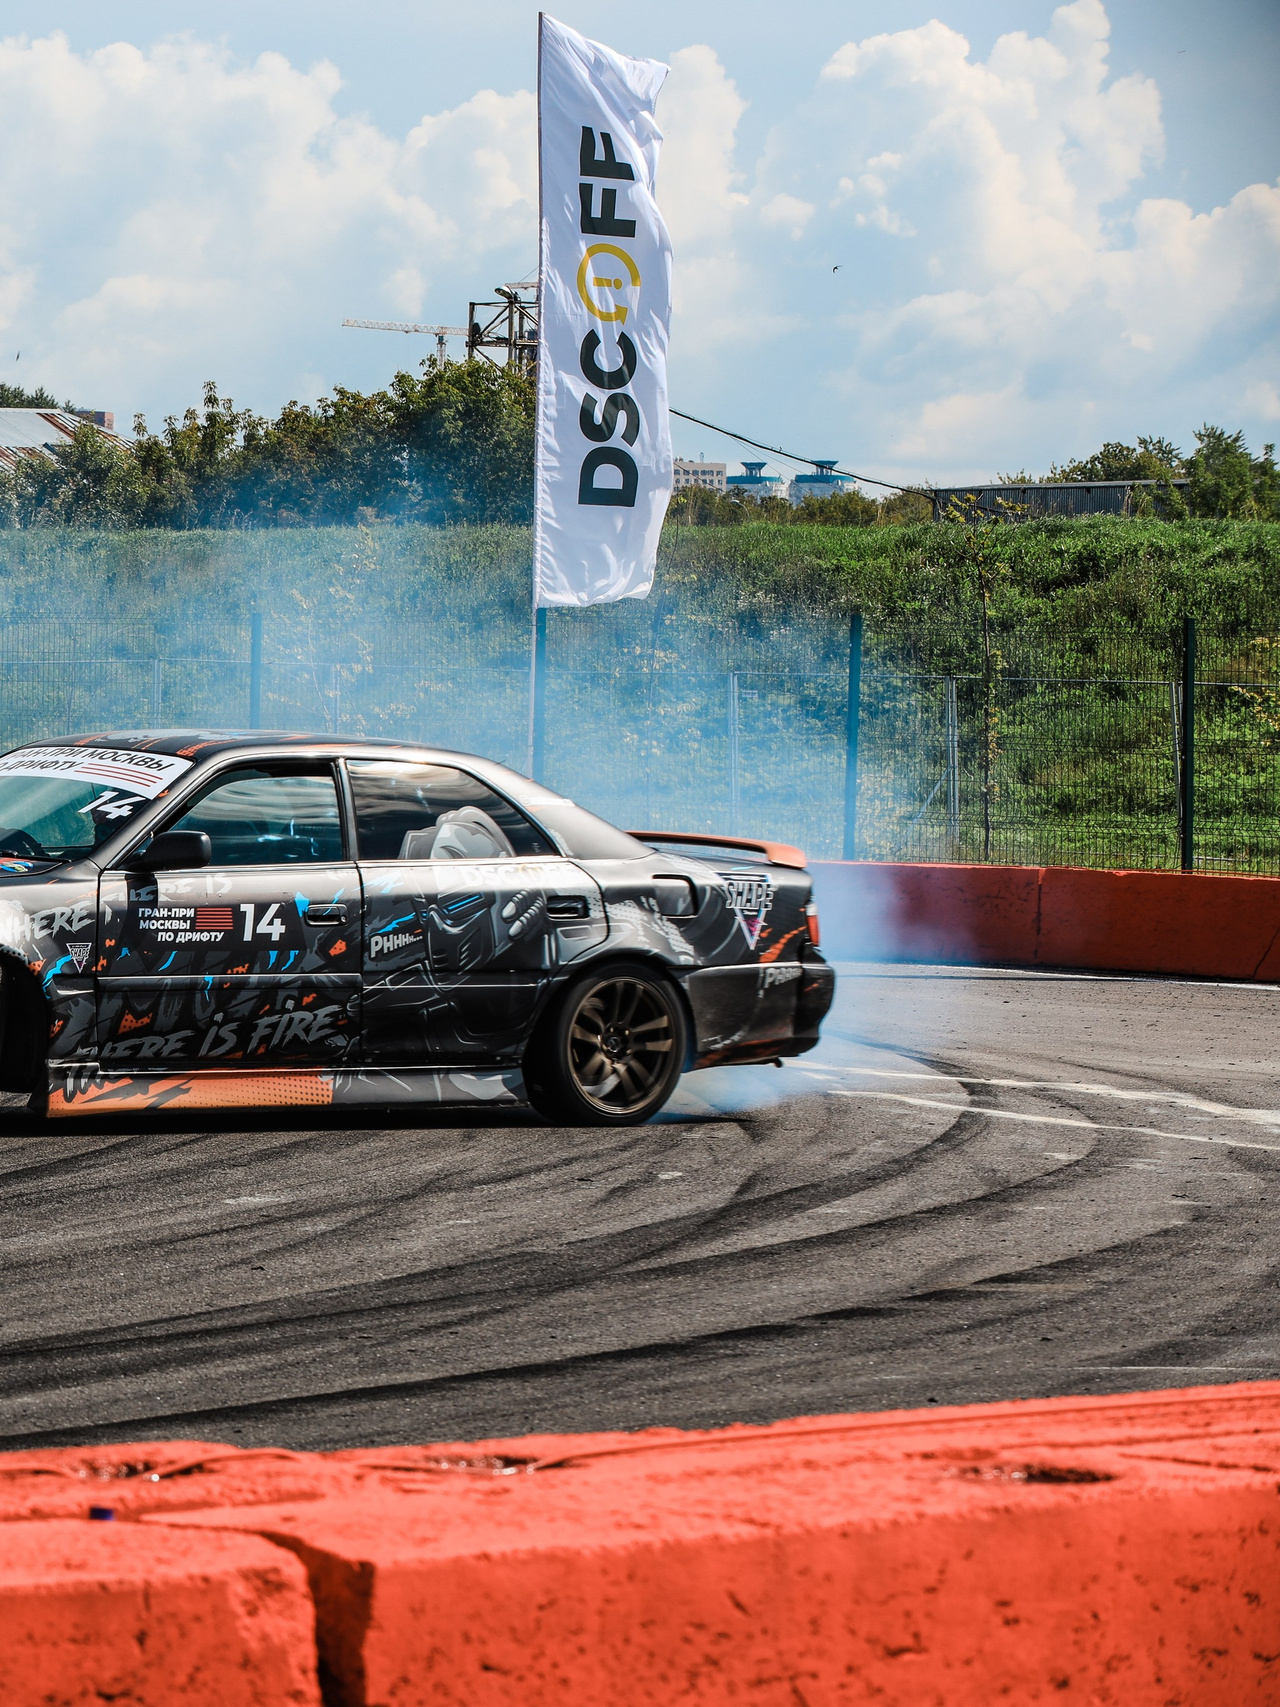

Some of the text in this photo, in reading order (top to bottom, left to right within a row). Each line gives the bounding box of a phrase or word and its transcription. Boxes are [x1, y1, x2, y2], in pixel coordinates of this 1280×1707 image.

[3, 759, 84, 773] ДРИФТУ
[82, 749, 175, 772] МОСКВЫ
[78, 790, 146, 820] 14
[138, 908, 195, 918] ГРАН-ПРИ
[139, 919, 191, 929] МОСКВЫ
[239, 903, 286, 942] 14
[157, 932, 224, 943] ПО ДРИФТУ
